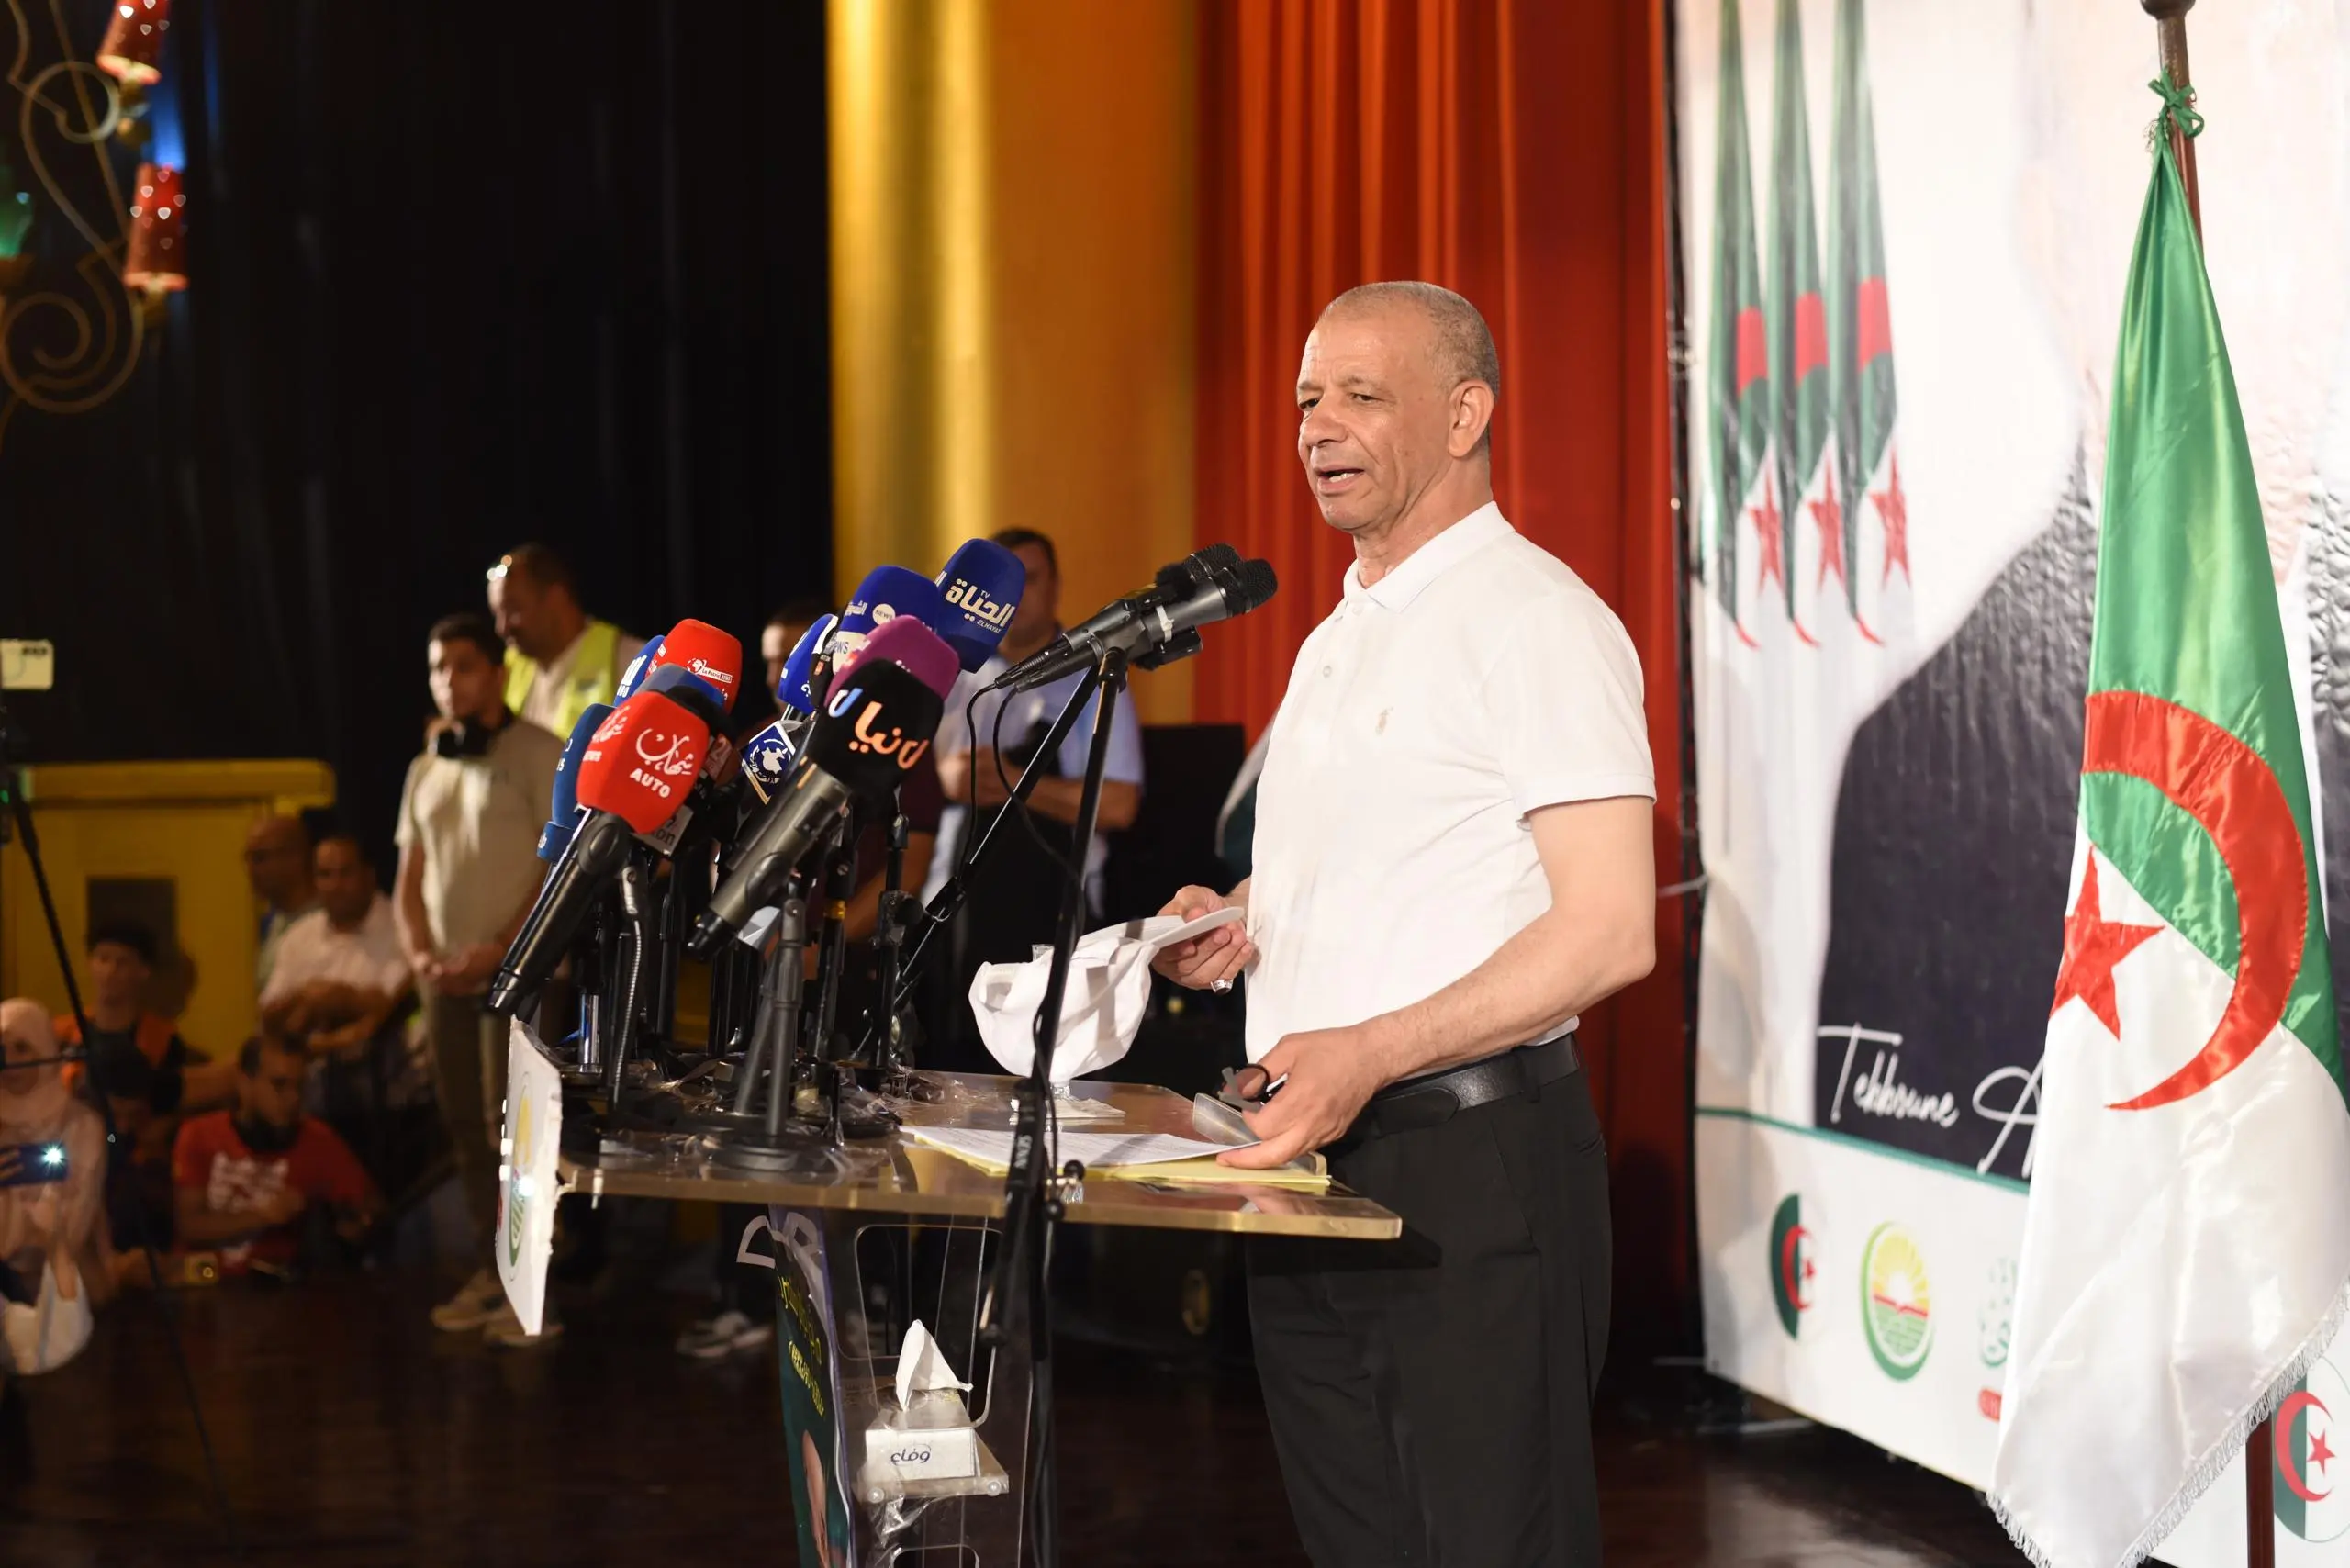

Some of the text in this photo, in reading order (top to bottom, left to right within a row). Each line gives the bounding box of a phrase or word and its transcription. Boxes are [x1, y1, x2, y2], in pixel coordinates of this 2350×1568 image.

[945, 578, 1016, 628] الحياة
[980, 589, 991, 599] TV
[848, 700, 930, 769] دنيا
[629, 767, 672, 799] AUTO
